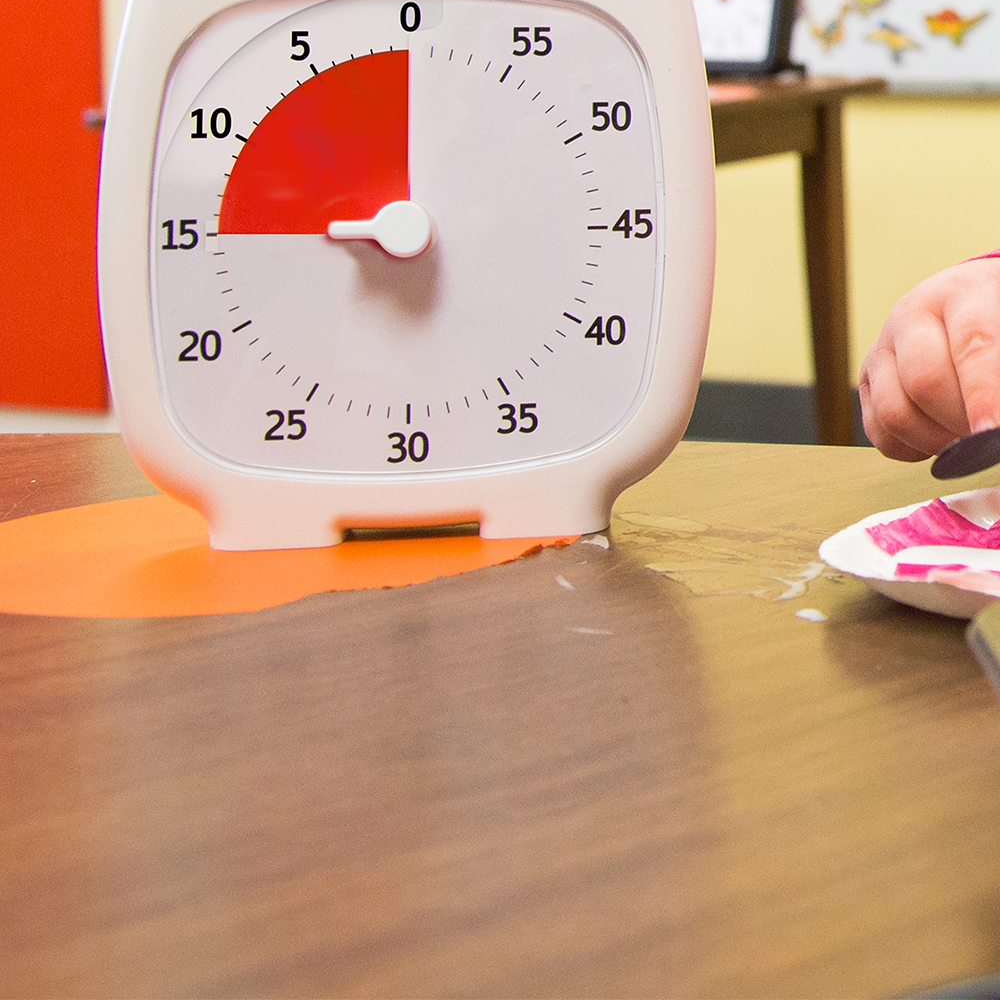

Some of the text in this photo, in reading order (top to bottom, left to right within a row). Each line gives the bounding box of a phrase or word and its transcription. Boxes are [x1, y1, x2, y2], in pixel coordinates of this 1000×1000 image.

[399, 1, 422, 33] 0
[290, 30, 311, 62] 5
[512, 26, 553, 57] 55
[190, 107, 232, 139] 10
[591, 101, 632, 132] 50
[161, 219, 199, 251] 15
[611, 208, 653, 239] 45
[178, 329, 222, 362] 20
[584, 314, 626, 346] 40
[264, 409, 307, 441] 25
[496, 402, 539, 435] 35
[386, 431, 430, 464] 30
